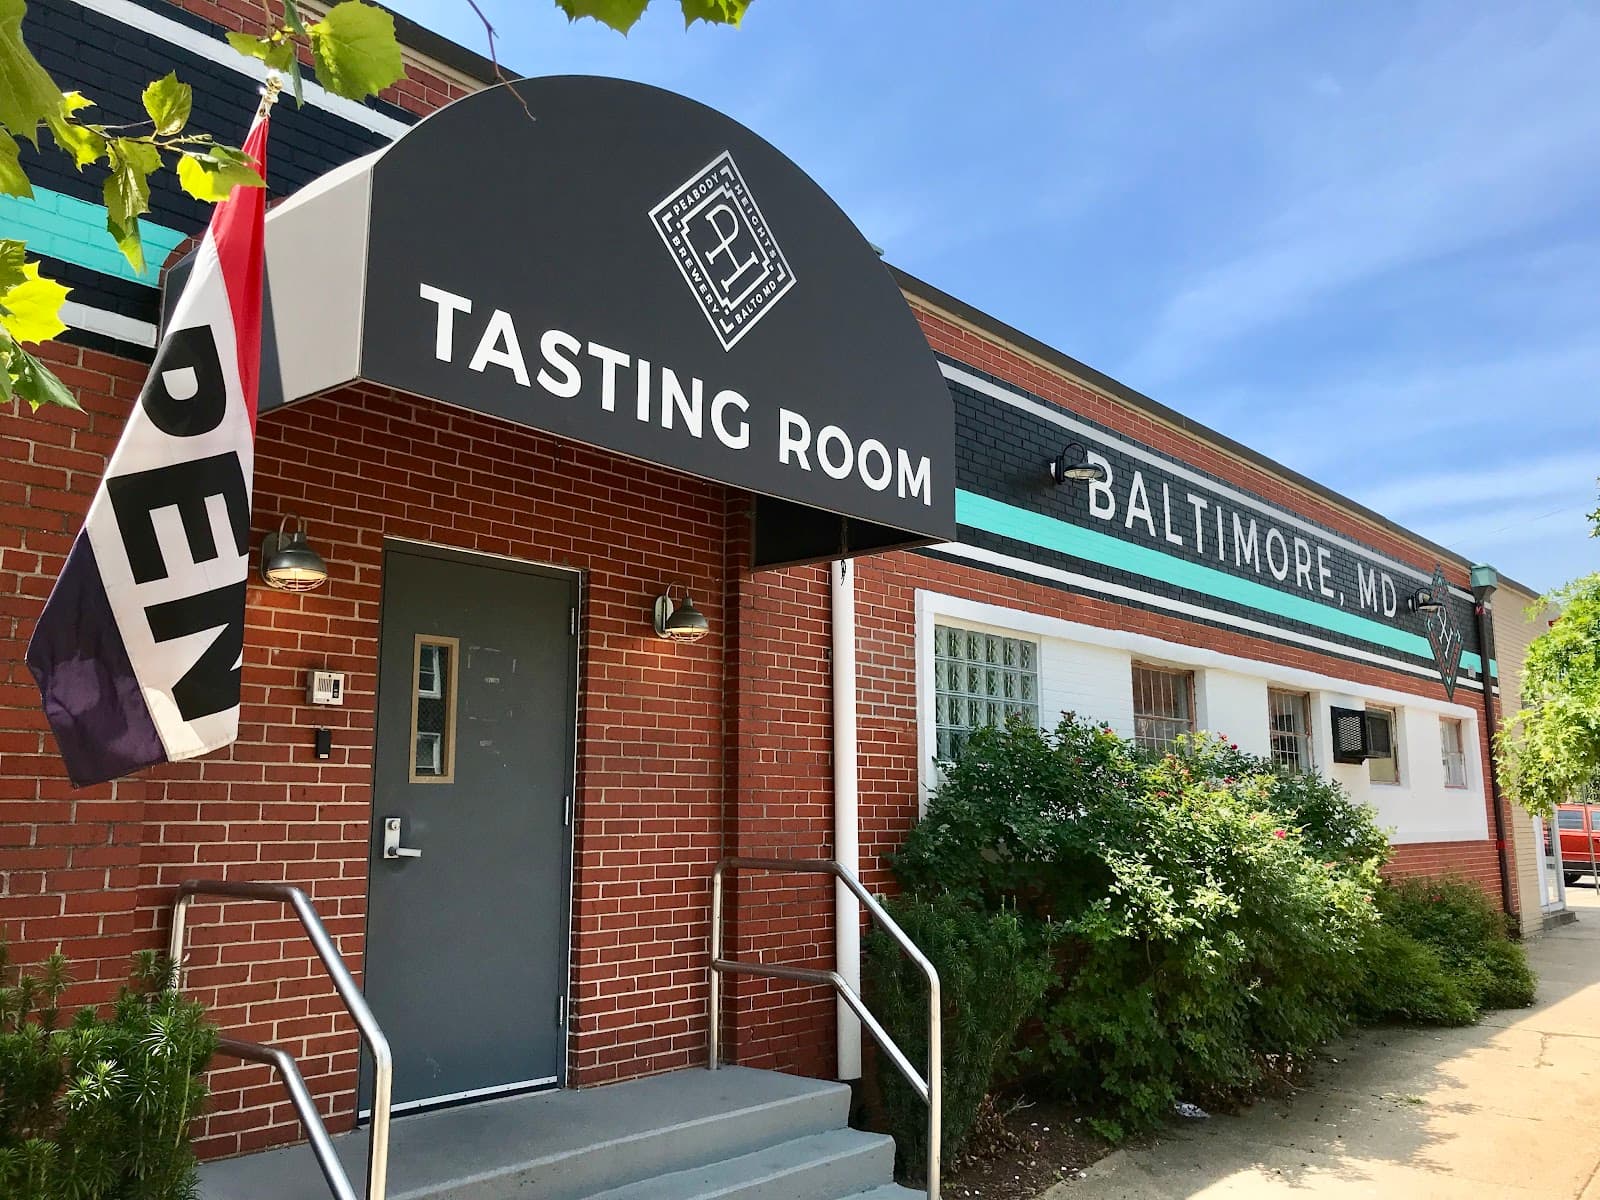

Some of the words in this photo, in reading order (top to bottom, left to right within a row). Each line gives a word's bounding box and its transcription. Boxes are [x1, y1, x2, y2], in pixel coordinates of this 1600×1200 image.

[673, 172, 720, 216] PEABODY
[734, 184, 777, 259] HEIGHTS
[672, 237, 720, 314] BREWERY
[735, 294, 764, 325] BALTO
[762, 280, 777, 297] MD
[419, 282, 751, 450] TASTING
[778, 407, 931, 506] ROOM
[1087, 450, 1344, 607] BALTIMORE,
[1357, 562, 1397, 619] MD
